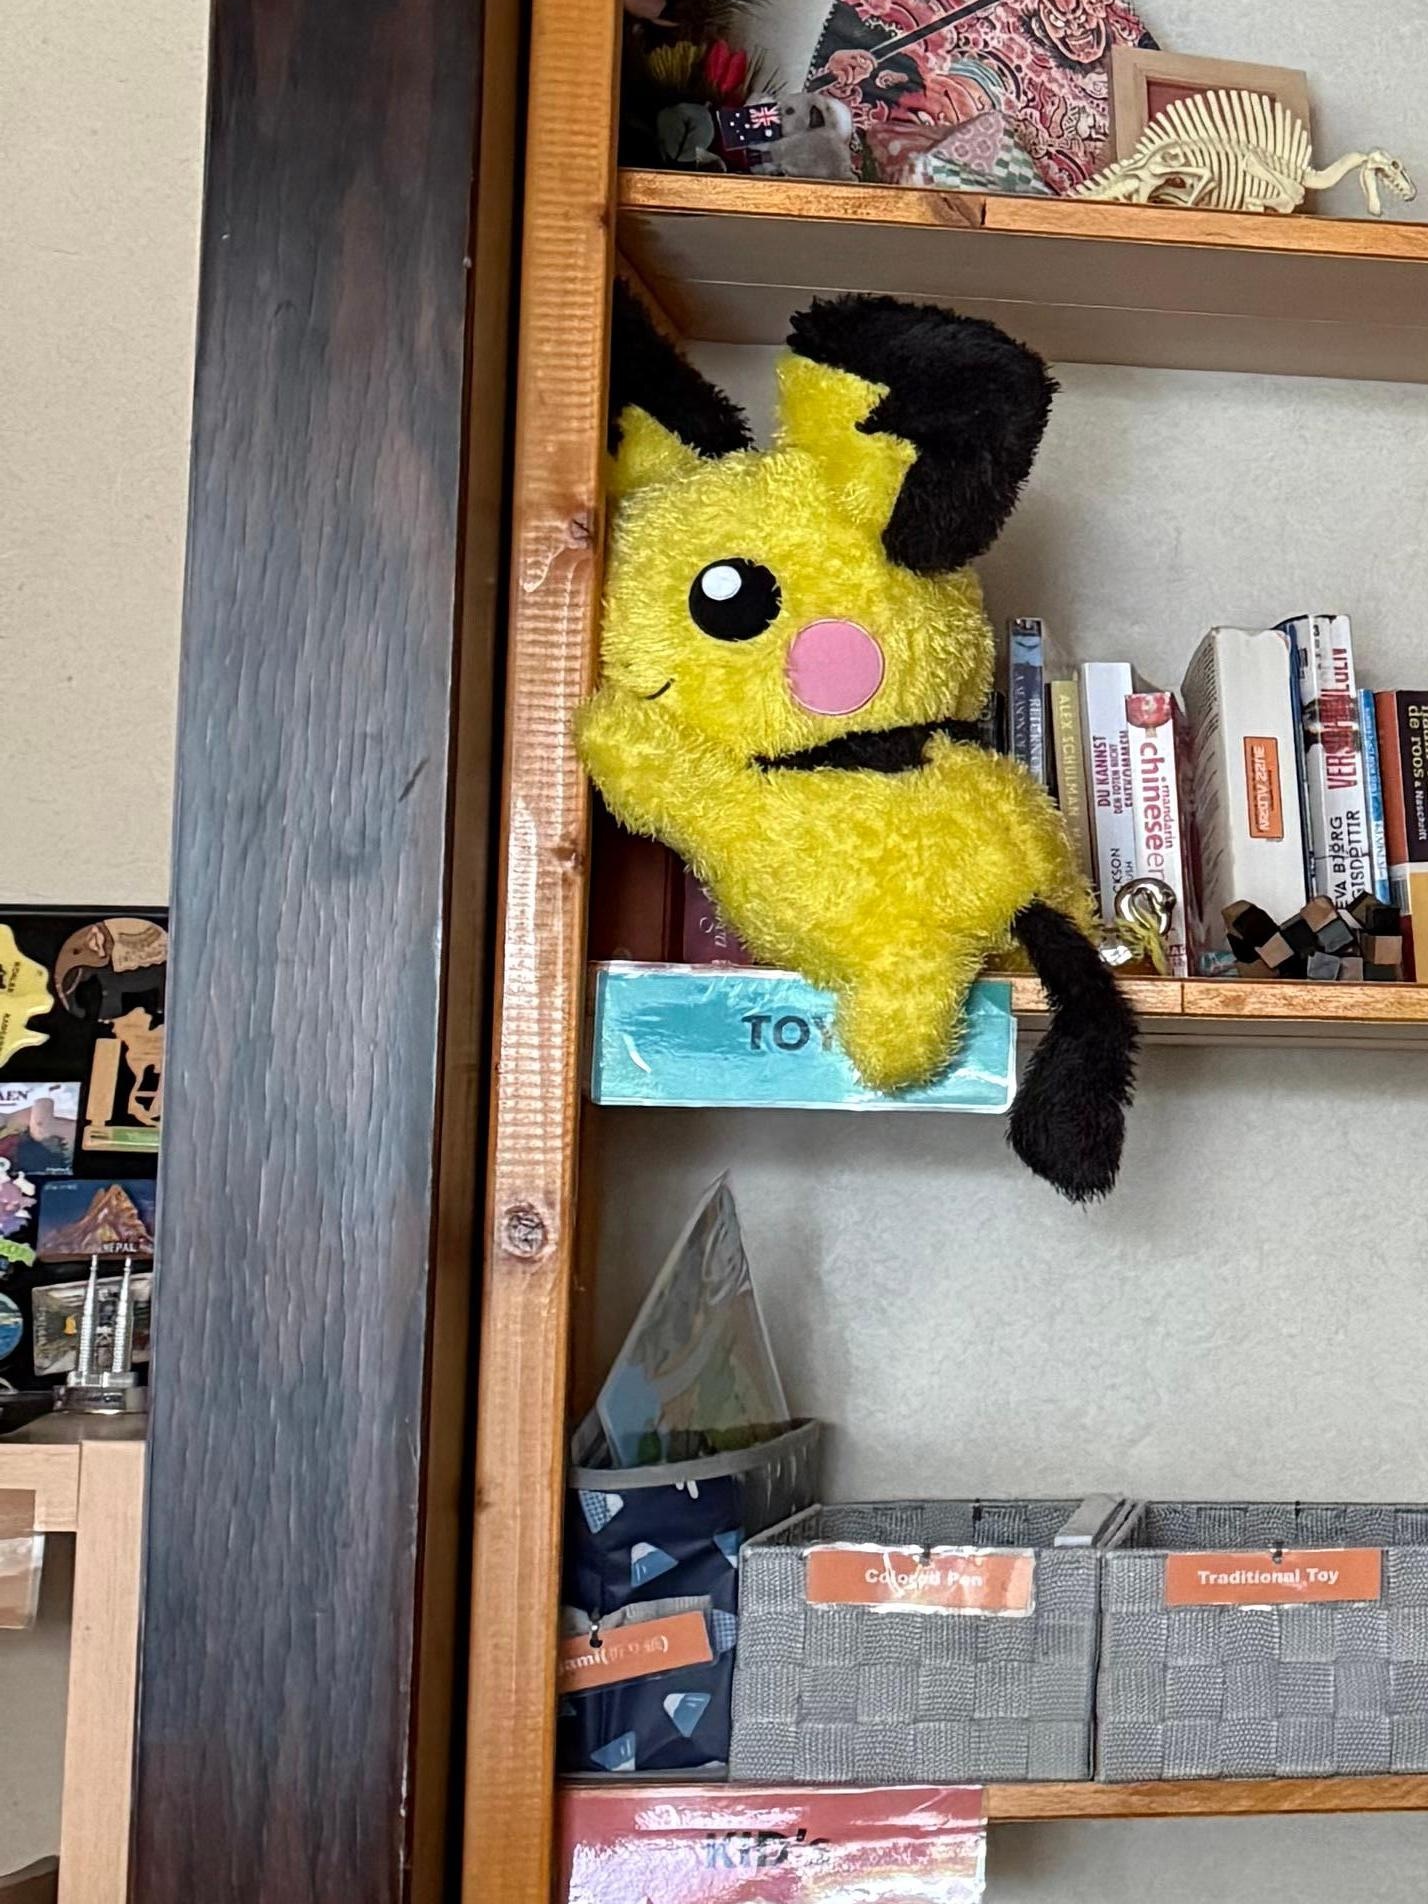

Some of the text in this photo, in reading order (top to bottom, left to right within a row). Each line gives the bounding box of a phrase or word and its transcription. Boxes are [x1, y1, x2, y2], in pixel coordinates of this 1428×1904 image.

[1405, 703, 1423, 729] de
[1057, 694, 1081, 816] ALEX SCHULMAN
[1091, 734, 1110, 807] DU KANNST
[1406, 735, 1428, 779] roos
[1159, 784, 1176, 849] mandarin
[945, 1567, 984, 1589] Pen
[1196, 1566, 1340, 1587] Traditional Toy
